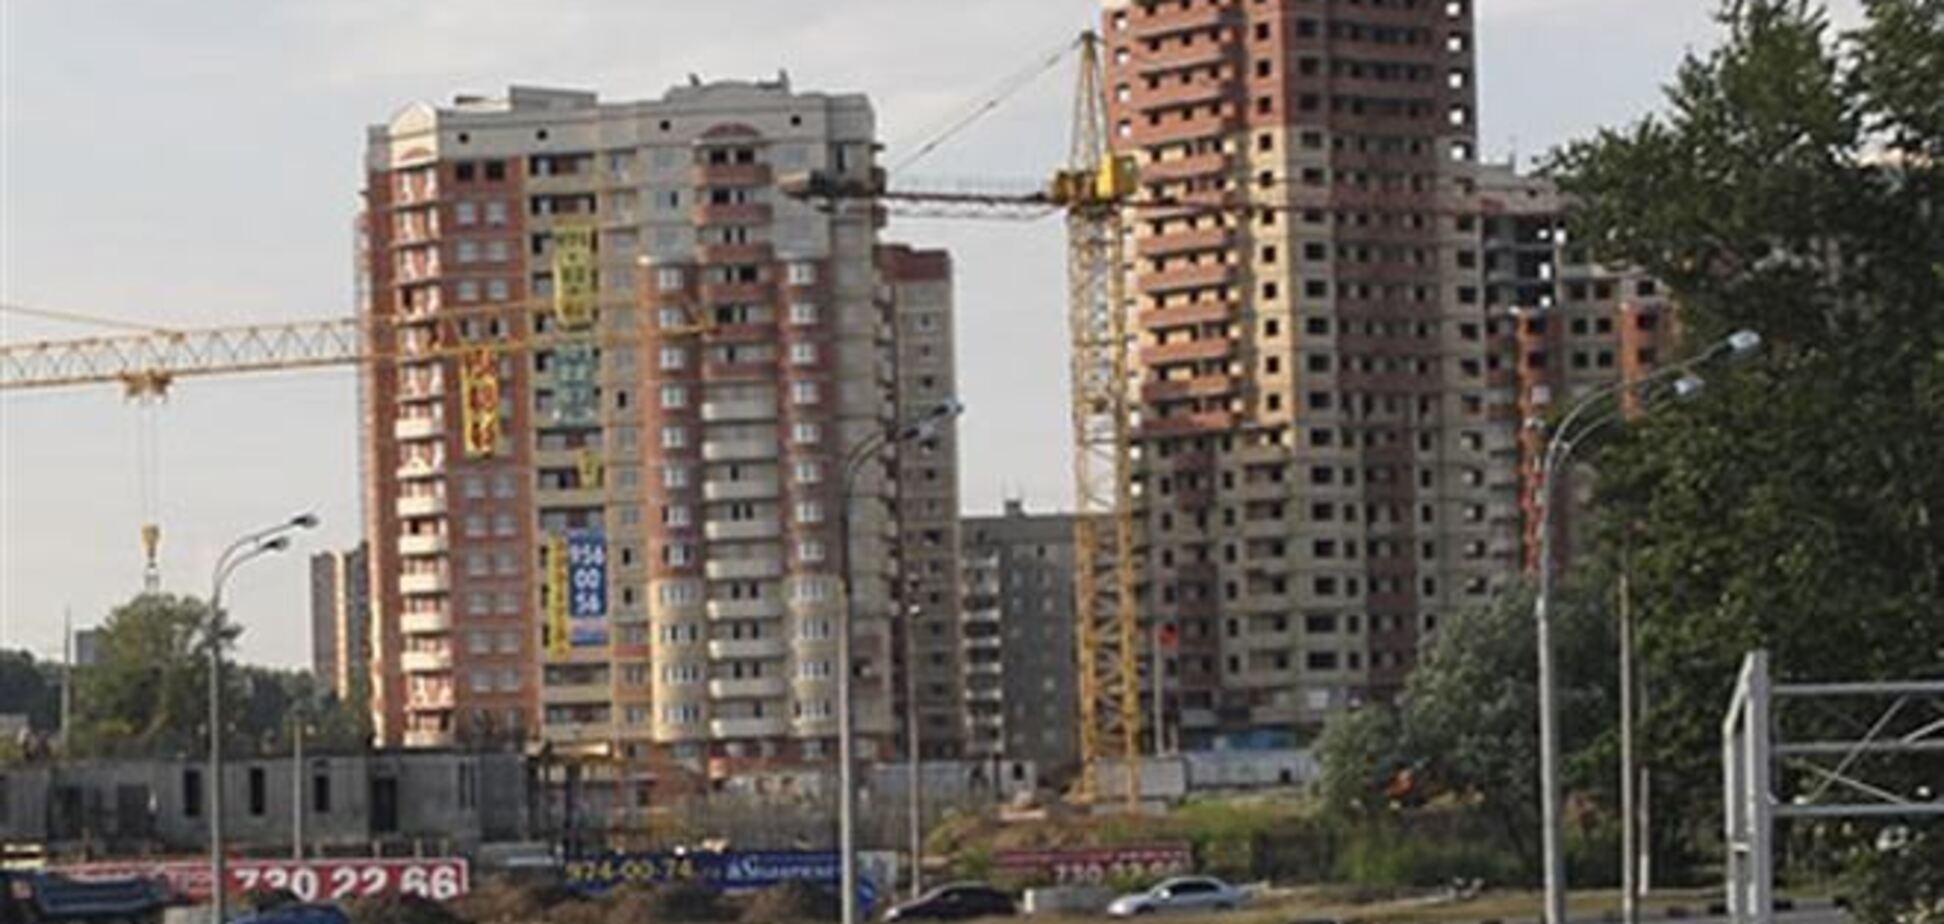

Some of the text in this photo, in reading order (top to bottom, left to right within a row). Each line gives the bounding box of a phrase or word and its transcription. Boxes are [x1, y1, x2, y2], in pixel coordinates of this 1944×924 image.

[570, 544, 603, 565] 956
[574, 568, 600, 589] 00
[575, 591, 601, 614] 56
